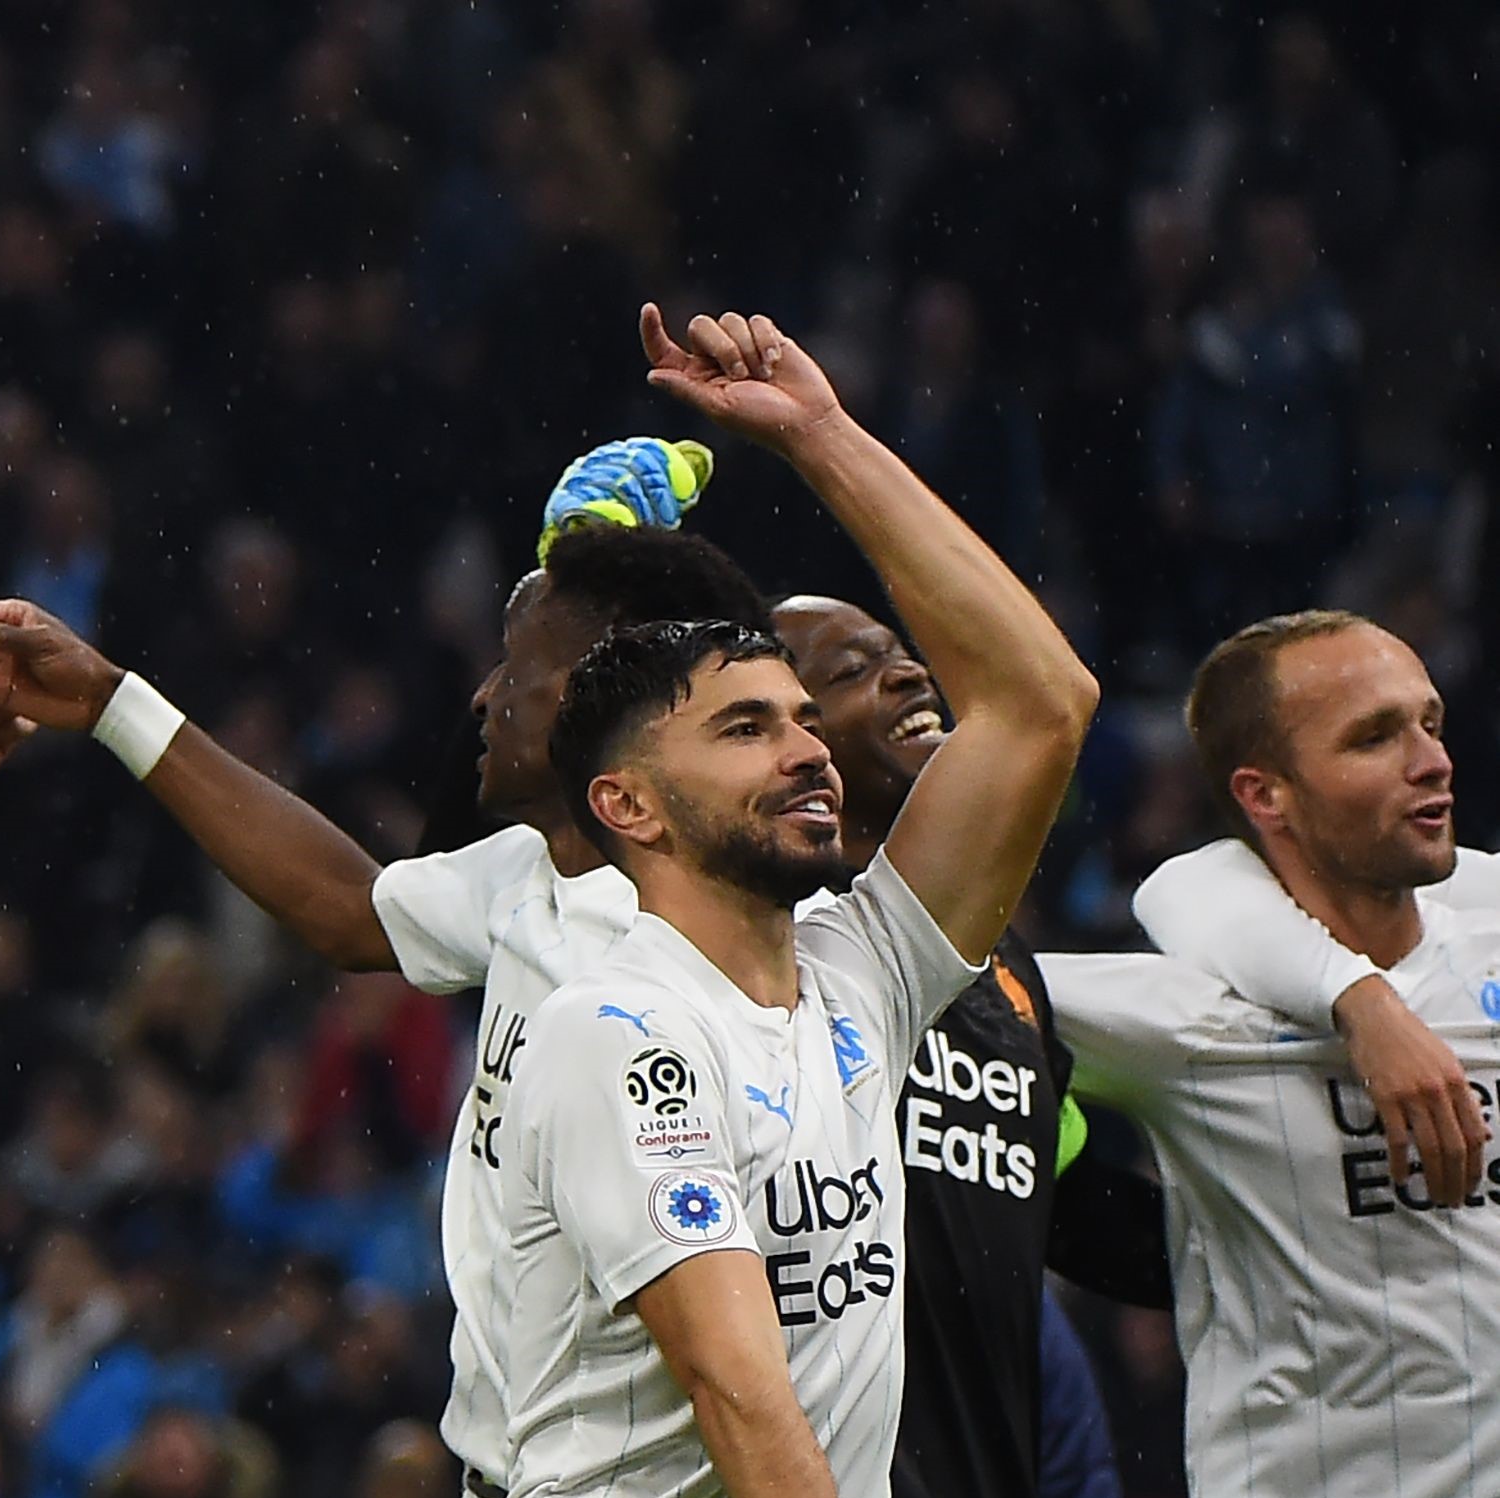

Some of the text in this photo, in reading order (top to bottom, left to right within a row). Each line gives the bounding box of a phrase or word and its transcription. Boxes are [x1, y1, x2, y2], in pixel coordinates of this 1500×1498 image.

[636, 1131, 711, 1146] Conforama
[640, 1117, 689, 1132] LIGUE
[905, 1097, 1036, 1198] Eats
[765, 1157, 883, 1236] Uber
